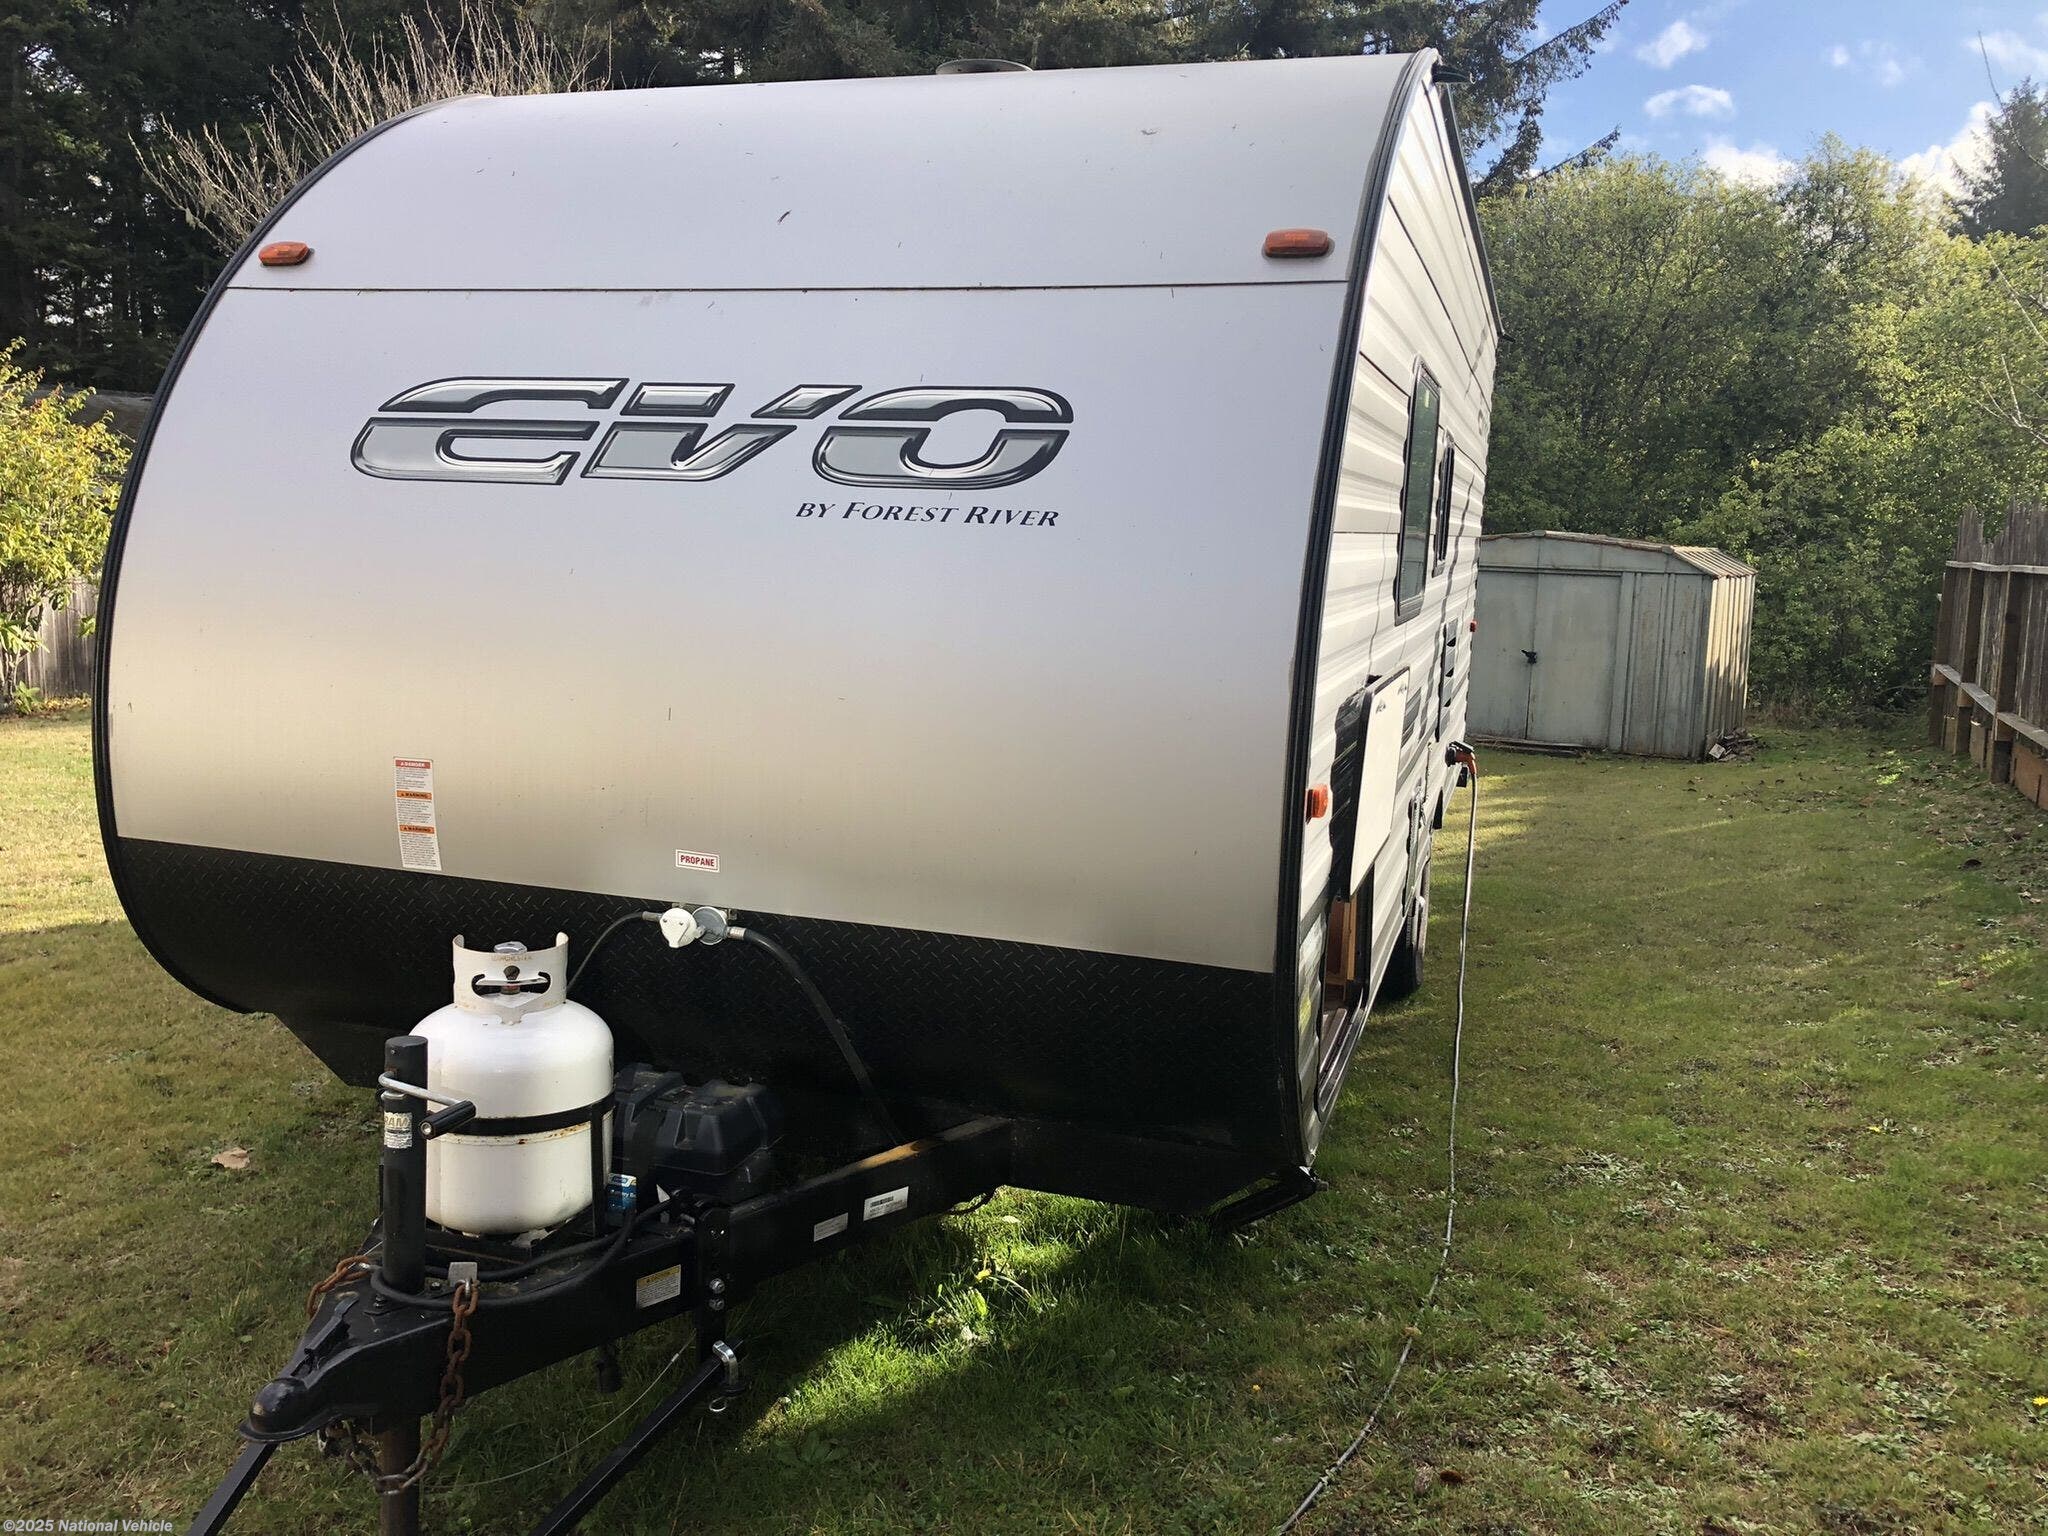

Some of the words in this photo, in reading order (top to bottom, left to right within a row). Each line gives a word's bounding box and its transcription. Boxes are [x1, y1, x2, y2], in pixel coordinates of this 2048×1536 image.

[350, 376, 1074, 489] EVO
[796, 502, 836, 519] BY
[680, 854, 715, 867] PROPANE
